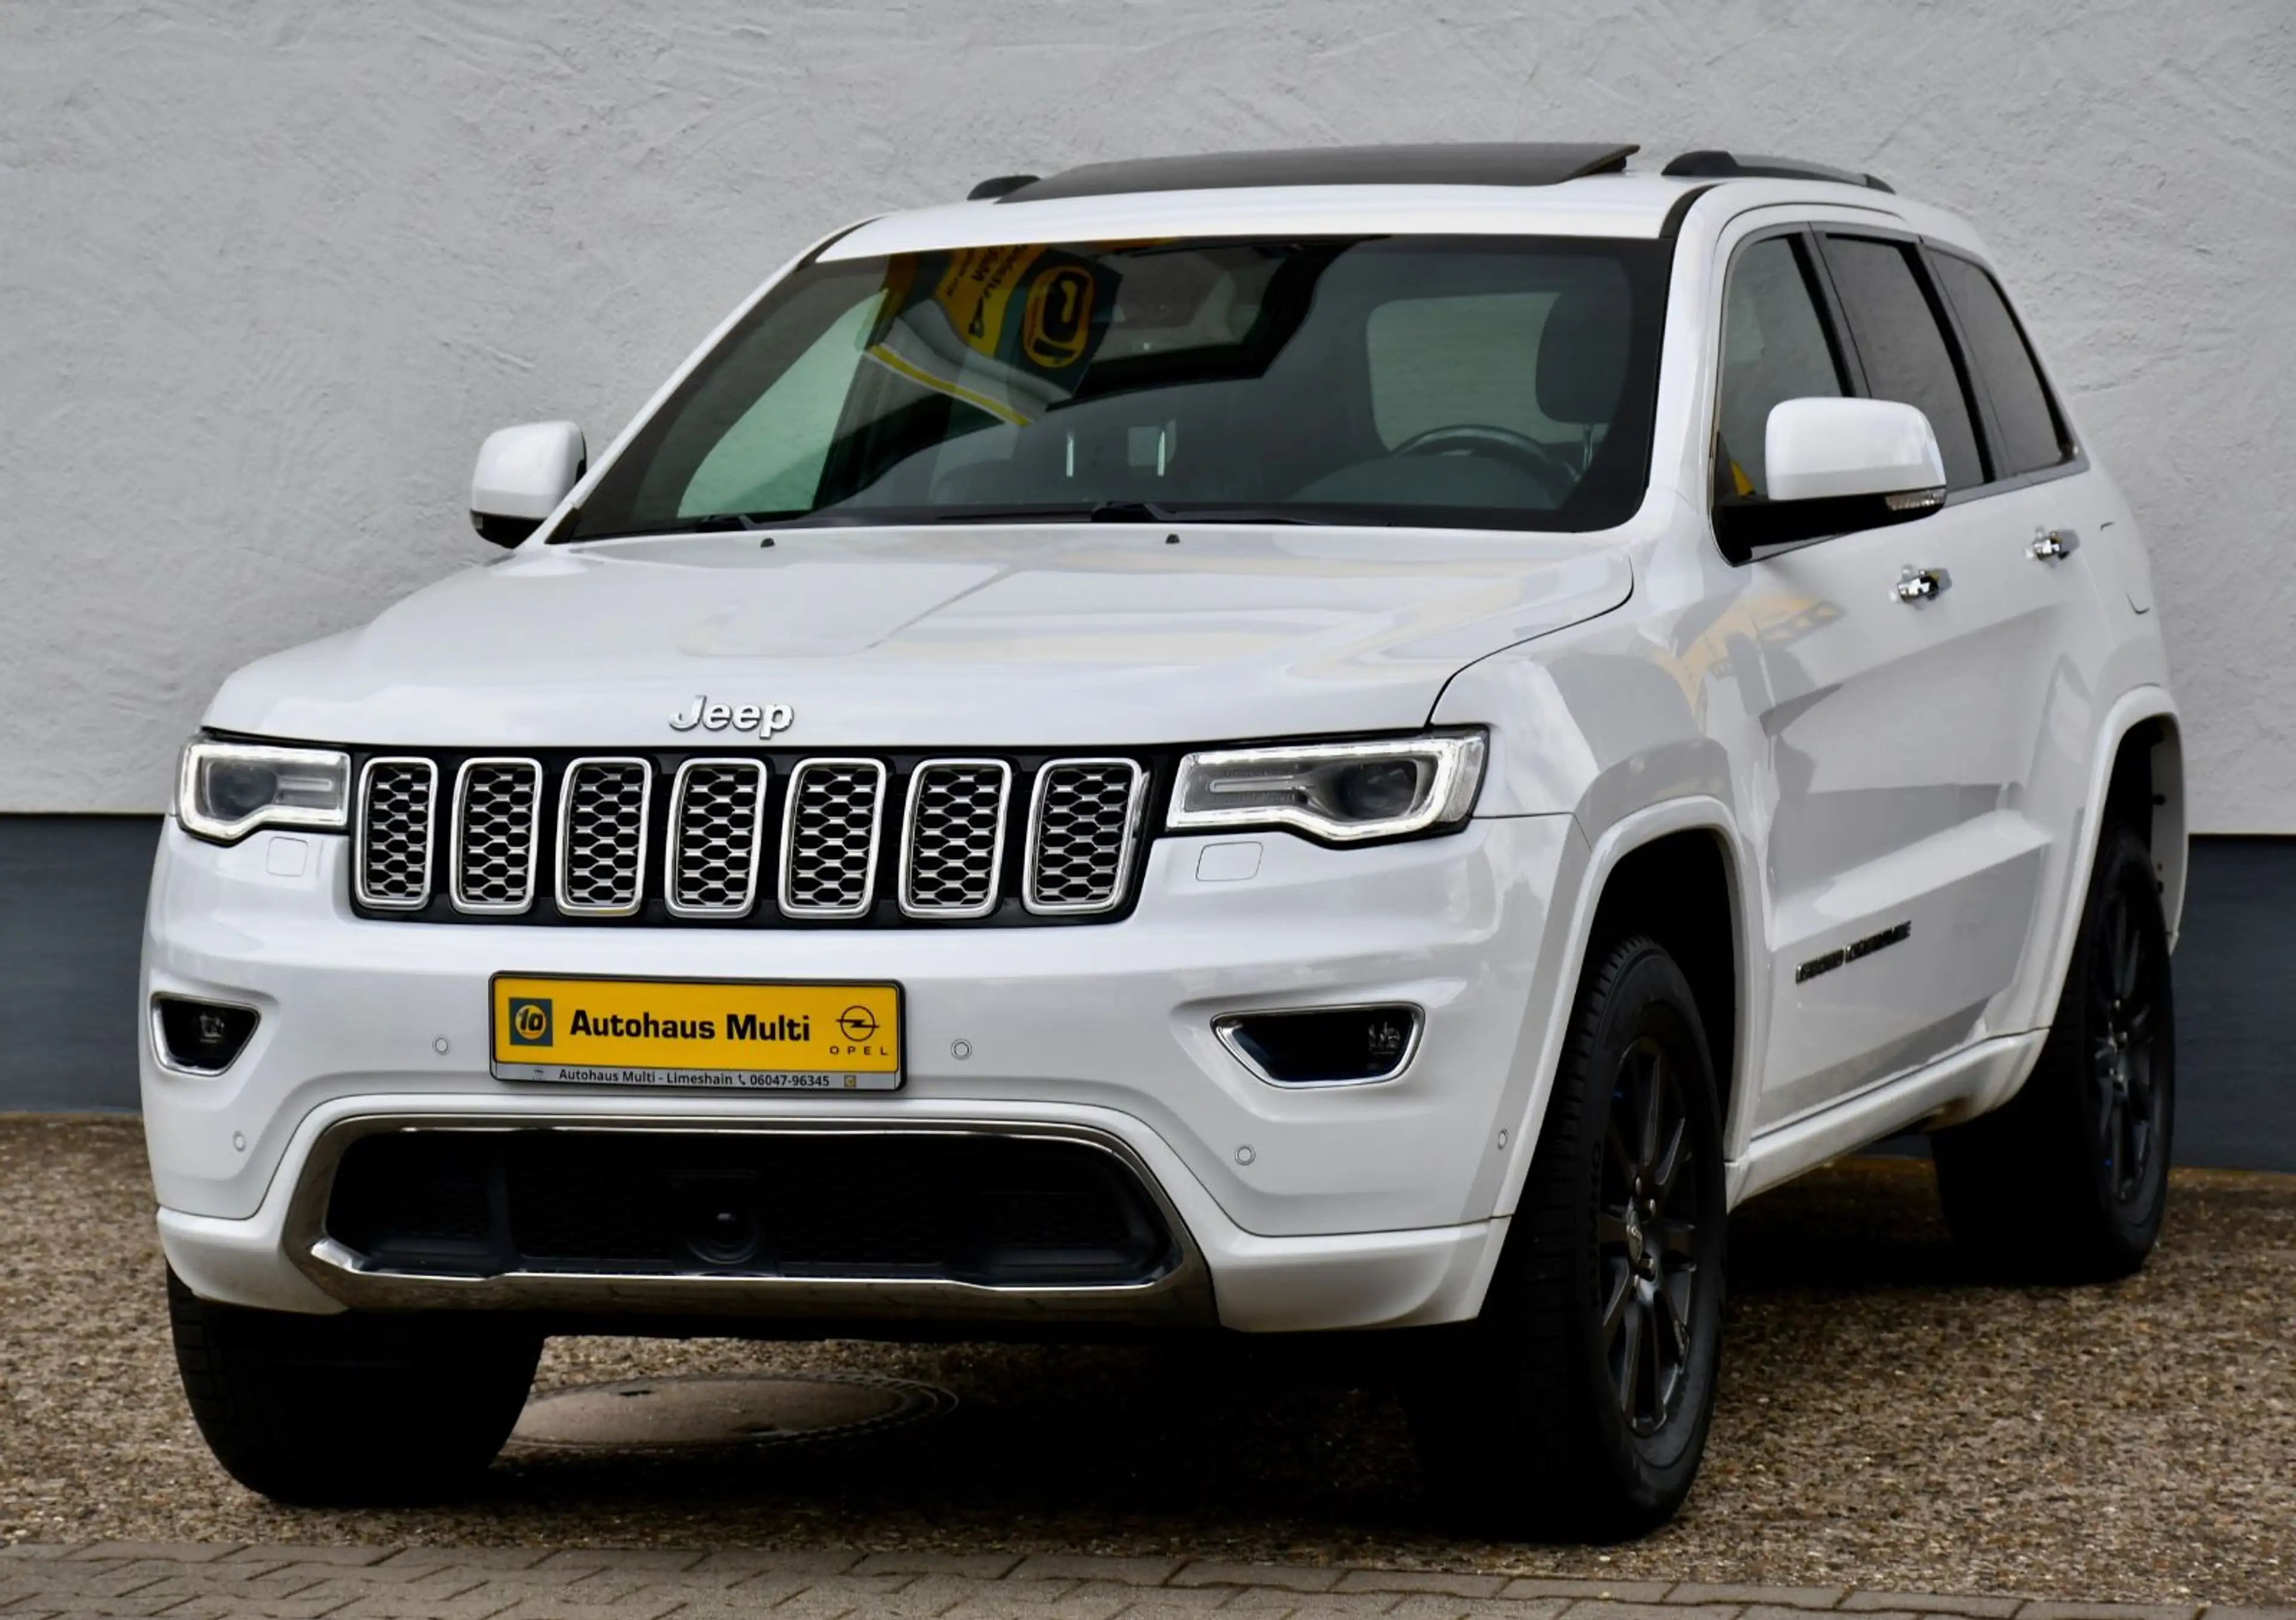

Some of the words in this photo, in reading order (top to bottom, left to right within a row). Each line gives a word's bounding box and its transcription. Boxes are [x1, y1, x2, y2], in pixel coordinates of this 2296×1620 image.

[668, 694, 794, 740] Jeep
[570, 1009, 715, 1040] Autohaus
[726, 1014, 810, 1042] Multi
[829, 1045, 888, 1055] OPEL
[559, 1069, 618, 1082] Autohaus
[622, 1070, 656, 1083] Multi
[667, 1072, 733, 1085] Limeshain
[750, 1075, 830, 1087] 06047-96345
